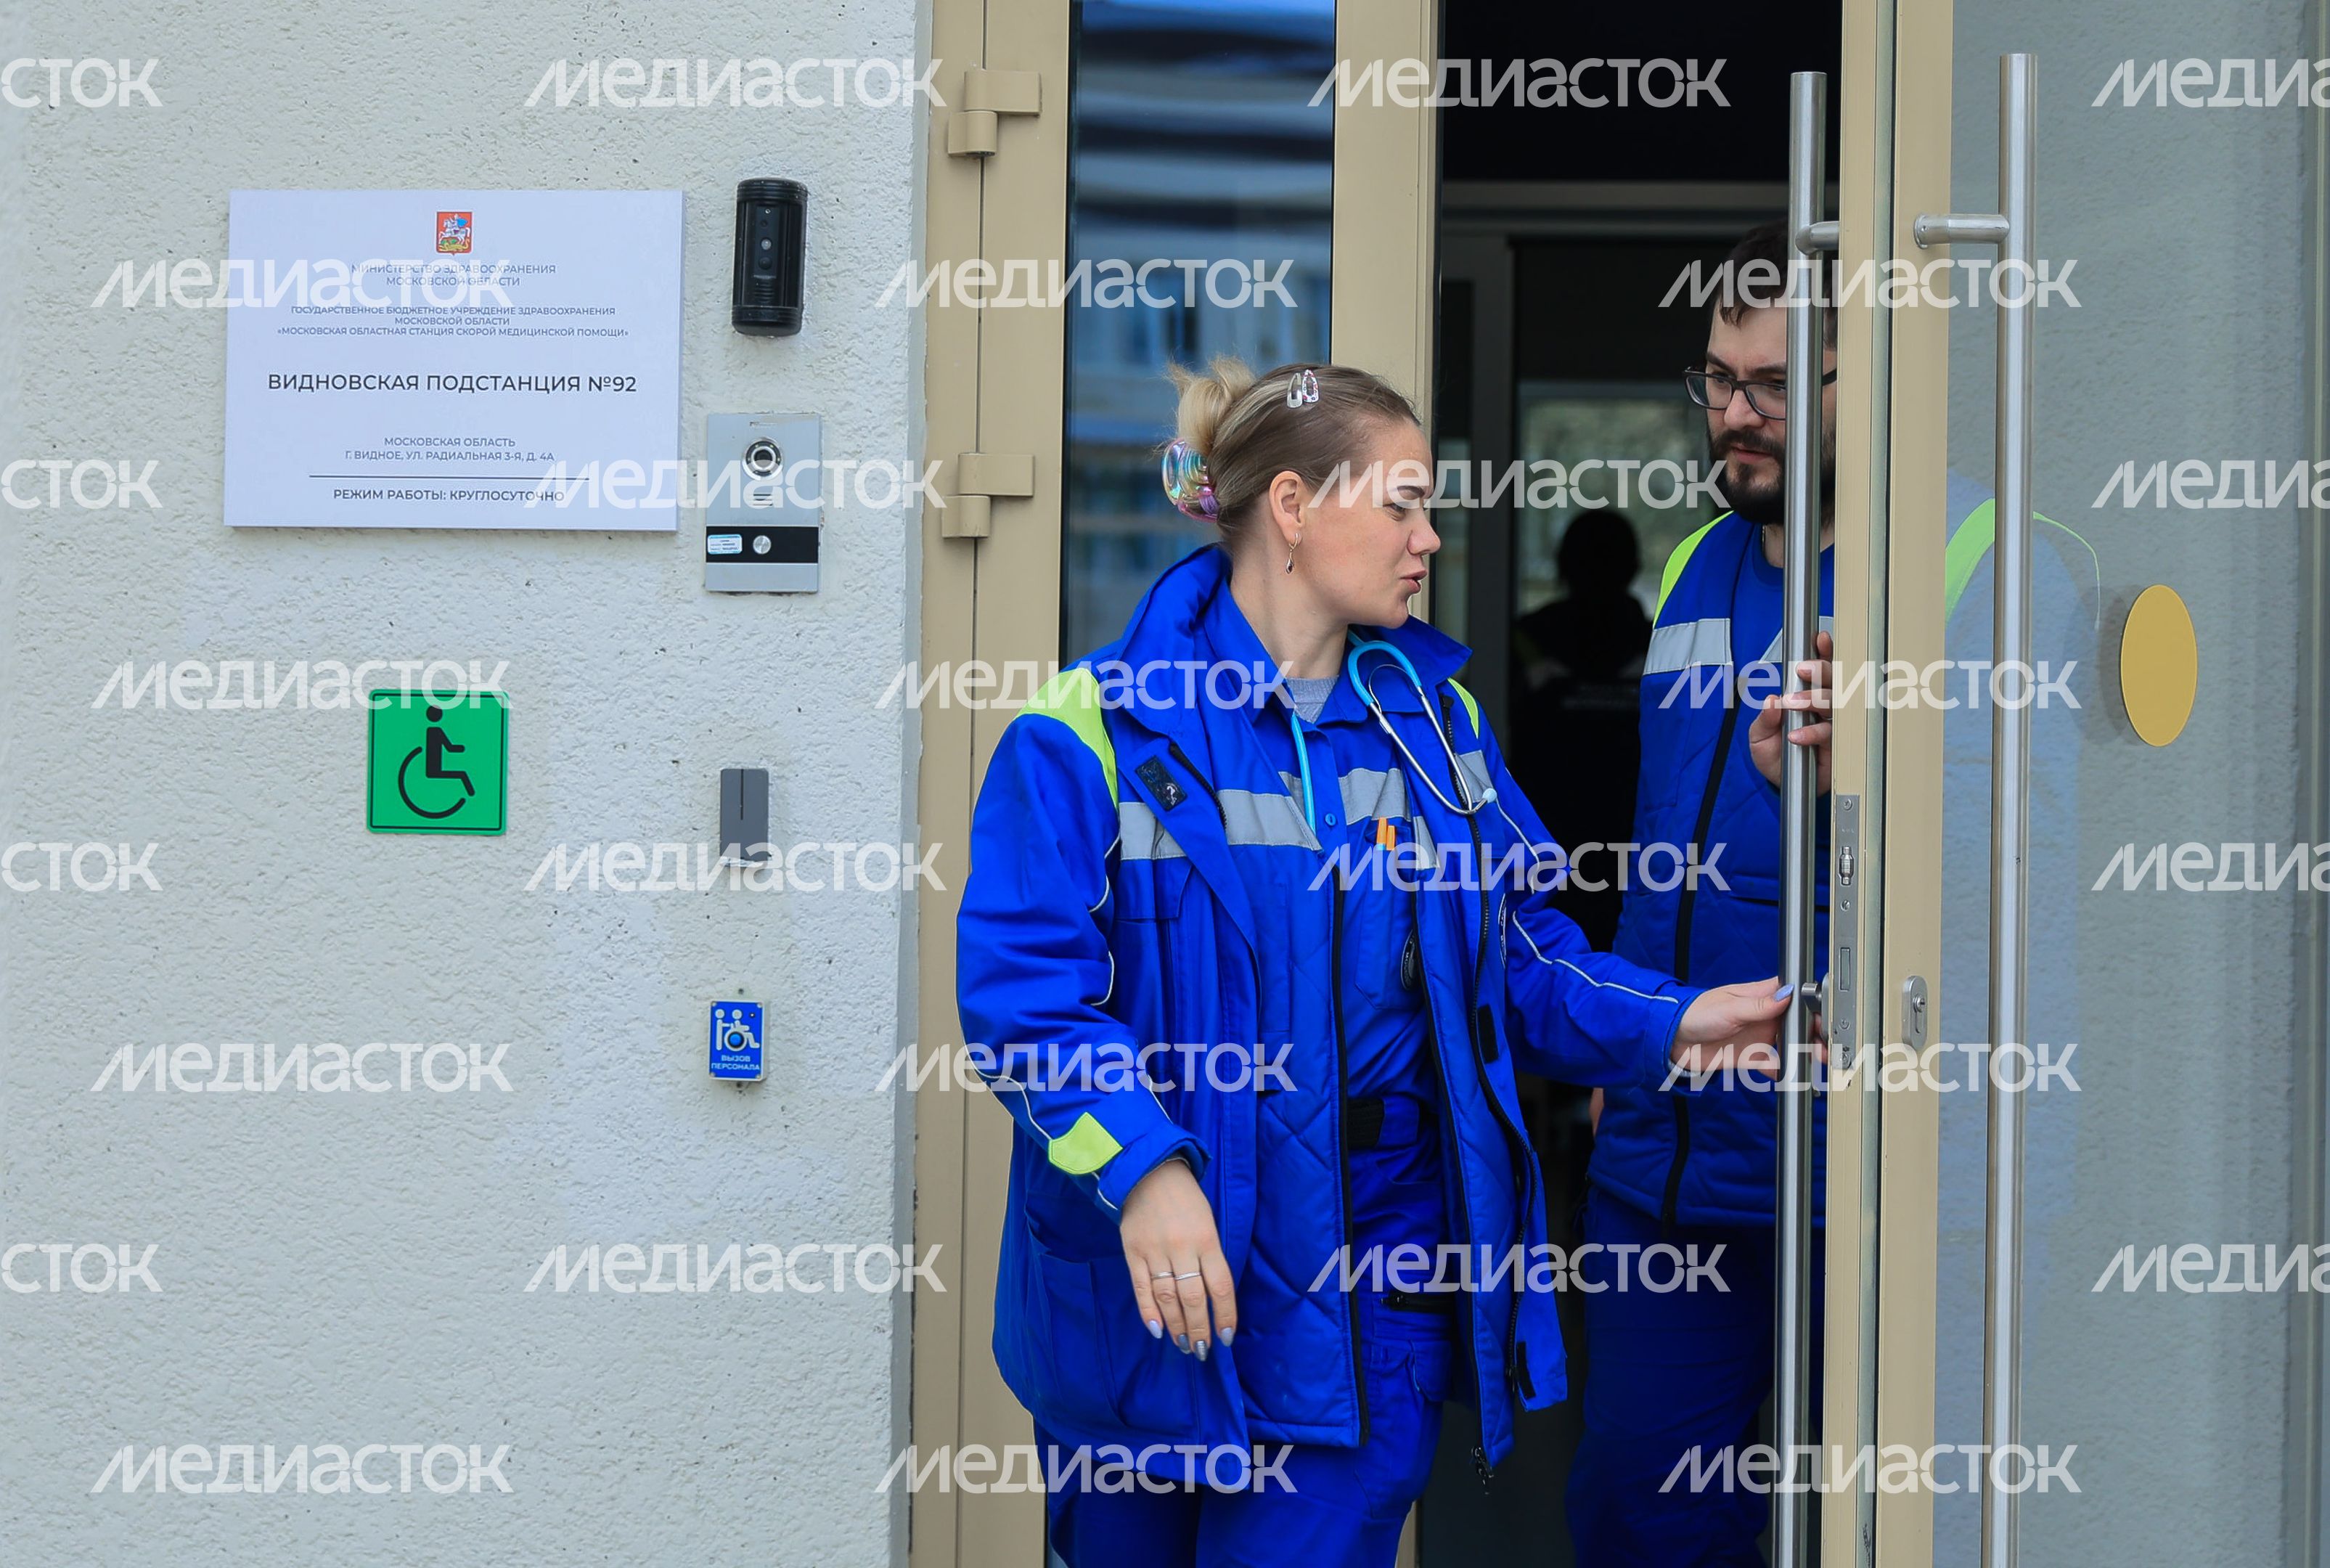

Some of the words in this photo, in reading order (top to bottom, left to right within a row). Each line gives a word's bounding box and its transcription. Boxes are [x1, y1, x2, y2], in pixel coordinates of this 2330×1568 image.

[351, 264, 441, 274] МИНИСТЕРСТВО
[443, 264, 556, 274] ЗДРАВООХРАНЕНИЯ
[387, 277, 465, 286] МОСКОВСКОЙ
[467, 277, 520, 286] ОБЛАСТИ
[291, 306, 384, 315] ГОСУДАРСТВЕННОЕ
[386, 306, 448, 315] БЮДЖЕТНОЕ
[450, 307, 516, 316] УЧРЕЖДЕНИЕ
[518, 307, 616, 316] ЗДРАВООХРАНЕНИЯ
[395, 317, 462, 325] МОСКОВСКОЙ
[465, 317, 510, 326] ОБЛАСТИ
[456, 327, 496, 336] СКОРОЙ
[499, 328, 574, 337] МЕДИЦИНСКОЙ
[577, 329, 629, 338] ПОМОЩИ»
[268, 374, 419, 393] ВИДНОВСКАЯ
[427, 375, 581, 393] ПОДСТАНЦИЯ
[588, 376, 637, 393] №92
[384, 437, 461, 446] МОСКОВСКАЯ
[463, 438, 516, 447] ОБЛАСТЬ
[345, 451, 352, 460] Г.
[355, 451, 404, 461] ВИДНОЕ,
[406, 452, 423, 460] УЛ.
[426, 452, 502, 462] РАДИАЛЬНАЯ
[504, 452, 524, 462] 3-Я,
[526, 452, 537, 462] Д.
[539, 453, 555, 462] 4А
[333, 489, 383, 500] РЕЖИМ
[387, 489, 446, 500] РАБОТЫ:
[449, 490, 565, 502] КРУГЛОСУТОЧНО
